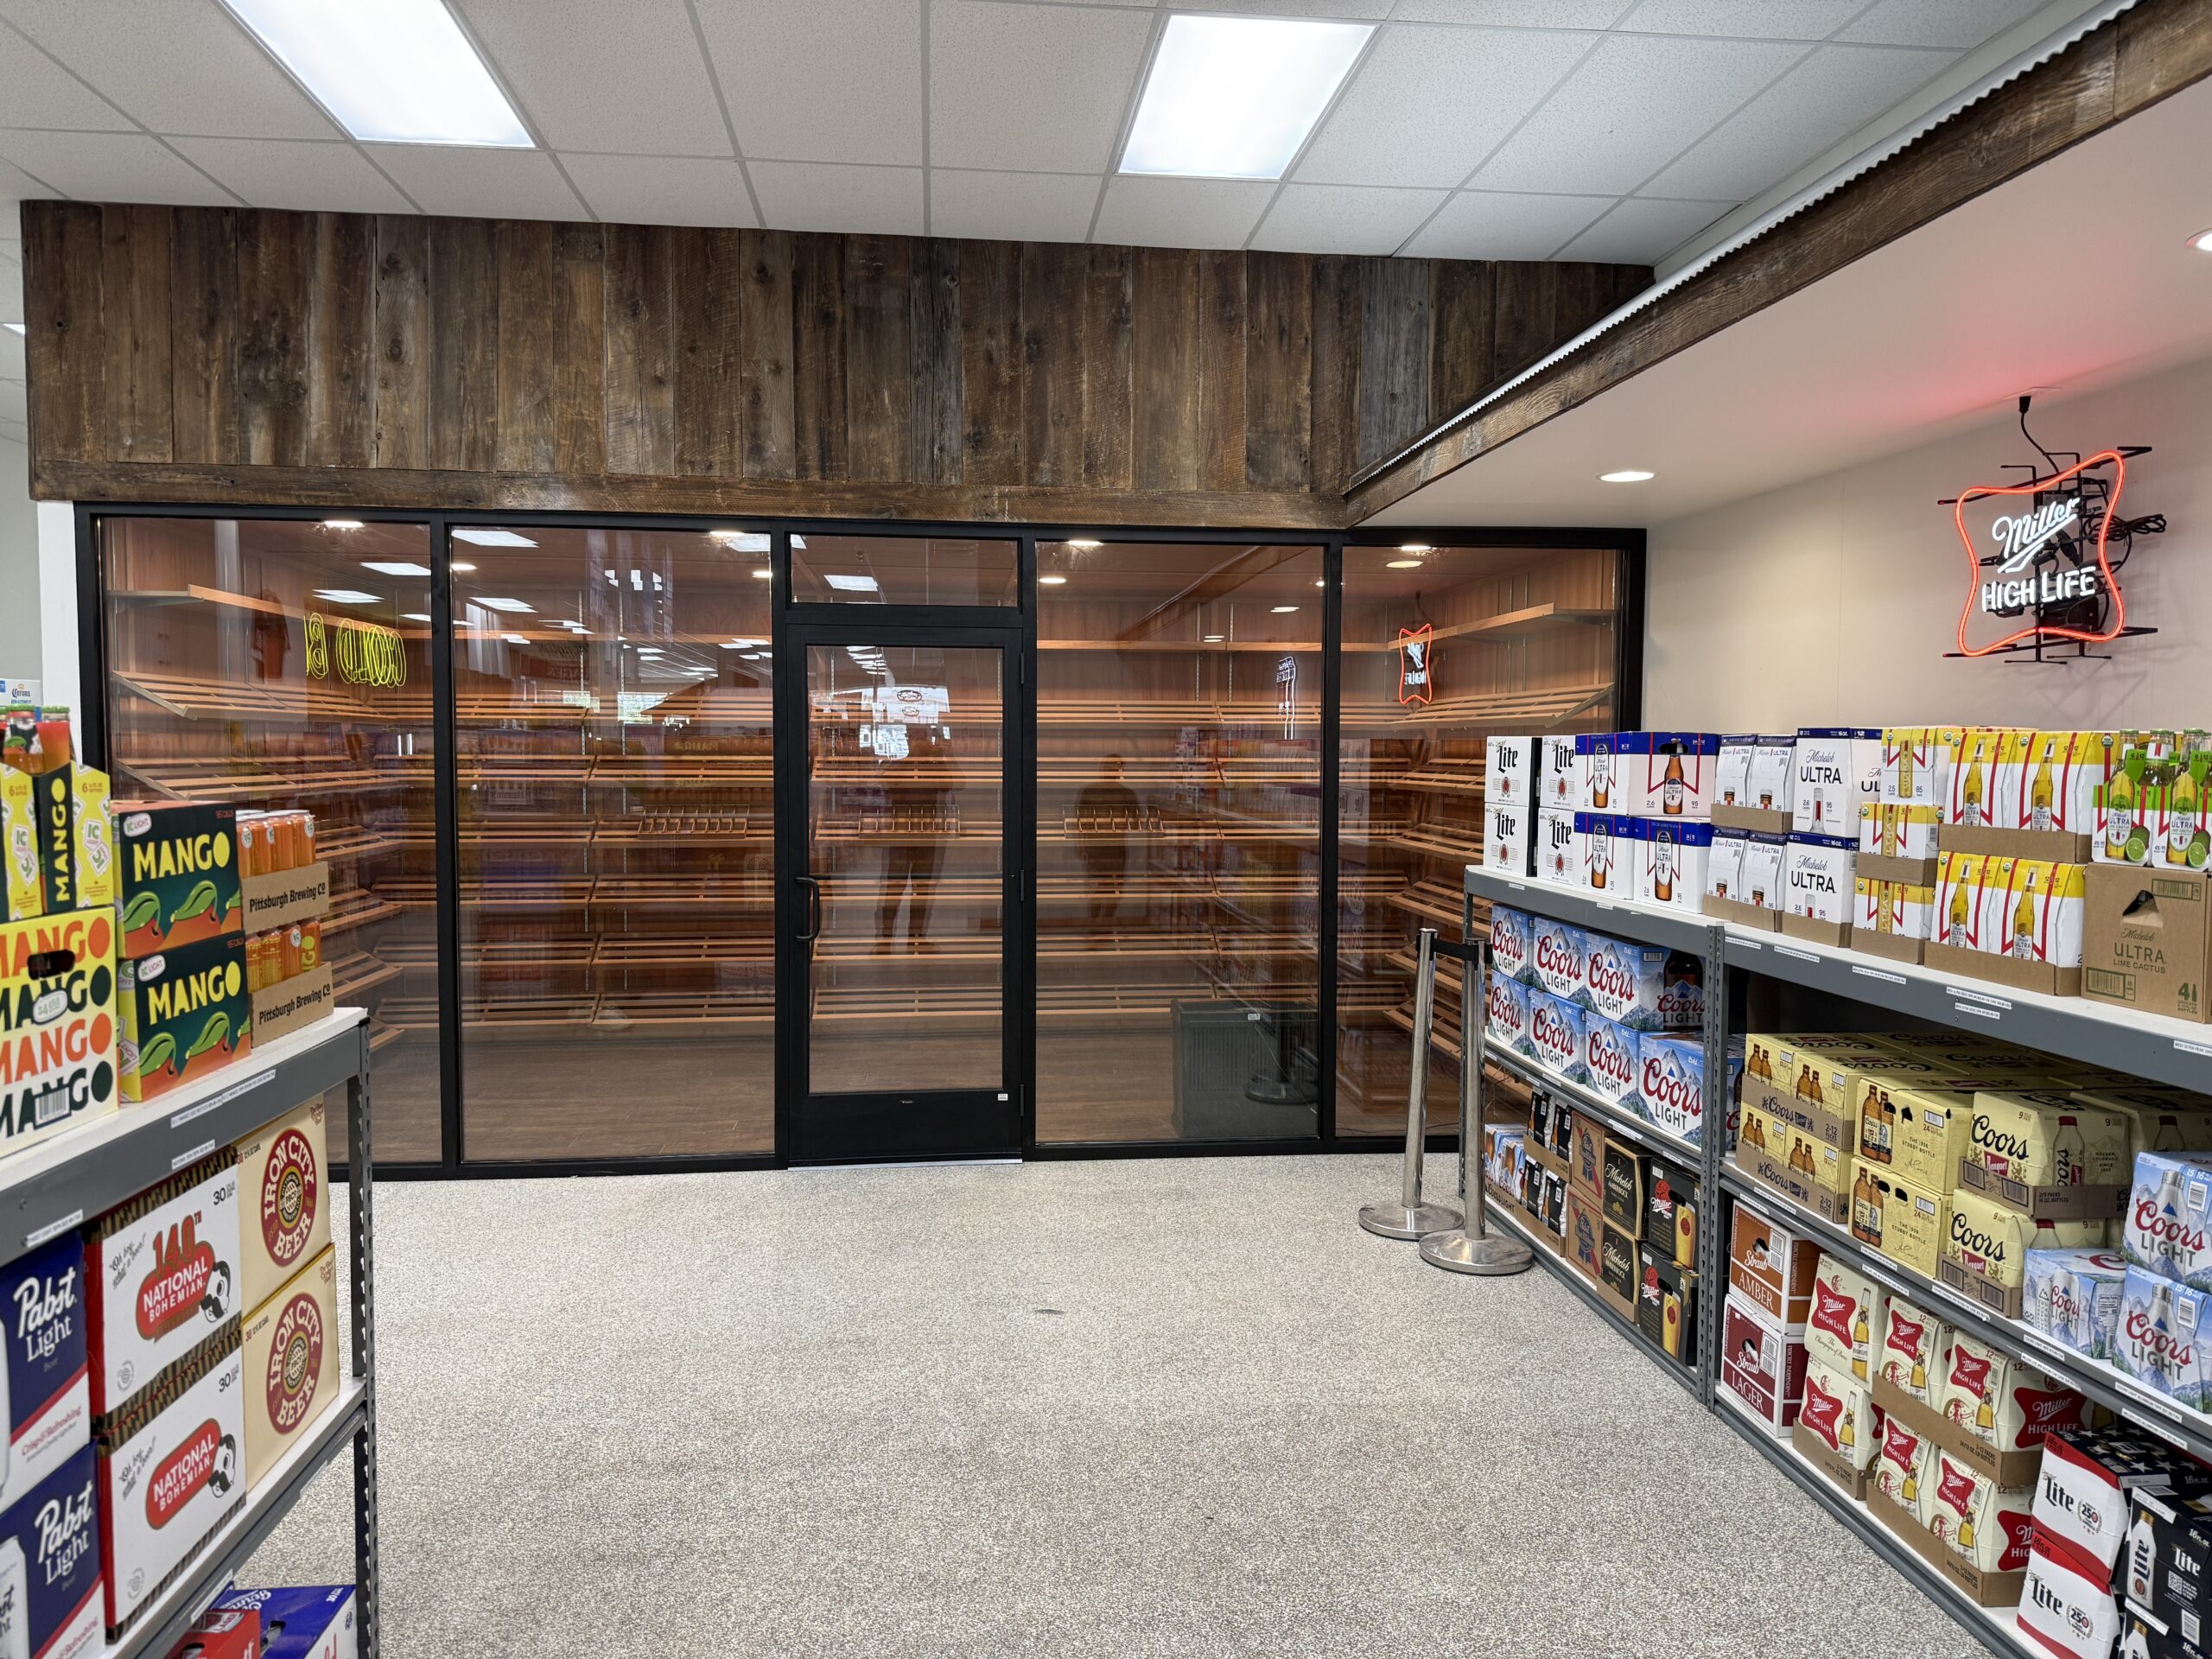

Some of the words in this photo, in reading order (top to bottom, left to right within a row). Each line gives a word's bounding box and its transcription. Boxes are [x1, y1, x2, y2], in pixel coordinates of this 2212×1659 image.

[1992, 497, 2081, 558] Miller
[1981, 579, 2037, 612] HIGH
[2041, 565, 2096, 603] LIFE
[1497, 746, 1518, 774] Lite
[1554, 744, 1574, 774] Lite
[1806, 749, 1835, 763] Michelob
[1800, 766, 1842, 785] ULTRA
[1496, 812, 1516, 841] Lite
[2108, 817, 2130, 825] ULTRA
[51, 778, 71, 902] MANGO
[1551, 819, 1572, 850] Lite
[133, 831, 230, 882] MANGO
[1796, 855, 1827, 871] Michelob
[1791, 871, 1837, 894] ULTRA
[249, 891, 289, 912] Pittsburgh
[289, 886, 317, 902] Brewing
[1492, 921, 1522, 961] Coors
[2120, 928, 2155, 942] Michelob
[1497, 954, 1516, 973] LIGHT
[1537, 935, 1582, 980] Coors
[2113, 942, 2166, 963] ULTRA
[1588, 952, 1635, 1001] Coors
[2113, 958, 2131, 968] LIME
[2133, 962, 2166, 974] CACTUS
[148, 961, 241, 1026] MANGO
[1546, 972, 1571, 993] LIGHT
[2178, 982, 2190, 1000] 4
[258, 1000, 296, 1026] Pittsburgh
[296, 989, 322, 1012] Brewing
[1491, 986, 1522, 1031] Coors
[1598, 995, 1624, 1015] LIGHT
[1657, 995, 1705, 1012] Coors
[1662, 1012, 1703, 1023] LIGHT
[1496, 1023, 1513, 1041] LIGHT
[1533, 1007, 1573, 1056] Coors
[1541, 1046, 1564, 1068] LIGHT
[1588, 1031, 1631, 1084] Coors
[1598, 1072, 1621, 1096] LIGHT
[1643, 1056, 1702, 1116] Coors
[1655, 1102, 1688, 1130] LIGHT
[1768, 1095, 1794, 1122] Coors
[1923, 1124, 1930, 1133] 24
[2105, 1118, 2111, 1127] 9
[1971, 1113, 2029, 1160] Coors
[1902, 1140, 1918, 1151] STUBBY
[1919, 1147, 1936, 1158] BOTTLE
[1986, 1154, 2008, 1176] Banquet
[2057, 1147, 2070, 1186] oors
[2186, 1168, 2195, 1178] 15
[2196, 1170, 2204, 1180] 16
[264, 1140, 287, 1220] IRON
[288, 1135, 315, 1185] CITY
[1605, 1163, 1633, 1191] Michelob
[1764, 1163, 1789, 1190] Coors
[213, 1187, 226, 1205] 30
[1650, 1197, 1673, 1211] Miller
[1914, 1210, 1921, 1218] 24
[2083, 1220, 2088, 1229] 9
[2135, 1198, 2205, 1252] Coors
[273, 1212, 311, 1259] BEER
[1891, 1225, 1909, 1237] STUBBY
[1910, 1233, 1926, 1244] BOTTLE
[1951, 1211, 2005, 1262] Coors
[1603, 1243, 1630, 1272] Michelob
[2140, 1230, 2196, 1268] LIGHT
[1745, 1250, 1768, 1272] Straub
[1964, 1253, 1985, 1271] Banquet
[143, 1256, 207, 1312] NATIONAL
[1641, 1282, 1659, 1297] Miller
[1738, 1271, 1774, 1311] AMBER
[2184, 1286, 2193, 1296] 16
[13, 1266, 76, 1339] Pabst
[1822, 1294, 1846, 1309] Miller
[1818, 1310, 1833, 1326] HIGH
[1834, 1320, 1847, 1335] LIFE
[1897, 1322, 1916, 1333] Miller
[1919, 1314, 1927, 1323] 12
[1943, 1325, 1953, 1334] 12
[2051, 1309, 2079, 1331] LIGHT
[26, 1315, 73, 1363] Light
[270, 1306, 295, 1391] IRON
[296, 1300, 321, 1346] CITY
[1815, 1334, 1833, 1354] Champagne
[1891, 1334, 1903, 1346] HIGH
[1904, 1343, 1915, 1353] LIFE
[2126, 1311, 2191, 1365] Coors
[1737, 1351, 1759, 1375] Straub
[1961, 1357, 1982, 1370] Miller
[1986, 1350, 1993, 1359] 12
[2132, 1341, 2183, 1381] LIGHT
[2013, 1363, 2024, 1371] 12
[219, 1373, 231, 1392] 30
[1732, 1370, 1764, 1412] LAGER
[1955, 1370, 1968, 1383] HIGH
[1968, 1378, 1981, 1391] LIFE
[276, 1374, 315, 1426] BEER
[1811, 1394, 1833, 1409] Miller
[2032, 1397, 2072, 1419] Miller
[1806, 1408, 1821, 1426] HIGH
[1820, 1422, 1833, 1436] LIFE
[2028, 1424, 2055, 1434] HIGH
[2057, 1423, 2078, 1433] LIFE
[1891, 1430, 1908, 1444] Miller
[1886, 1444, 1898, 1458] HIGH
[1898, 1452, 1909, 1466] LIFE
[152, 1433, 215, 1503] NATIONAL
[1946, 1471, 1966, 1485] Miller
[1942, 1485, 1954, 1500] HIGH
[1953, 1495, 1966, 1510] LIFE
[1997, 1485, 2007, 1494] 12
[2044, 1477, 2075, 1513] Lite
[34, 1480, 93, 1564] Pabst
[2081, 1503, 2098, 1524] 250
[2189, 1528, 2198, 1539] 16
[45, 1531, 89, 1586] Light
[2133, 1539, 2149, 1581] Lite
[2174, 1547, 2201, 1577] Lite
[2031, 1577, 2063, 1616] Lite
[2070, 1608, 2089, 1629] 250
[2183, 1642, 2190, 1652] 16
